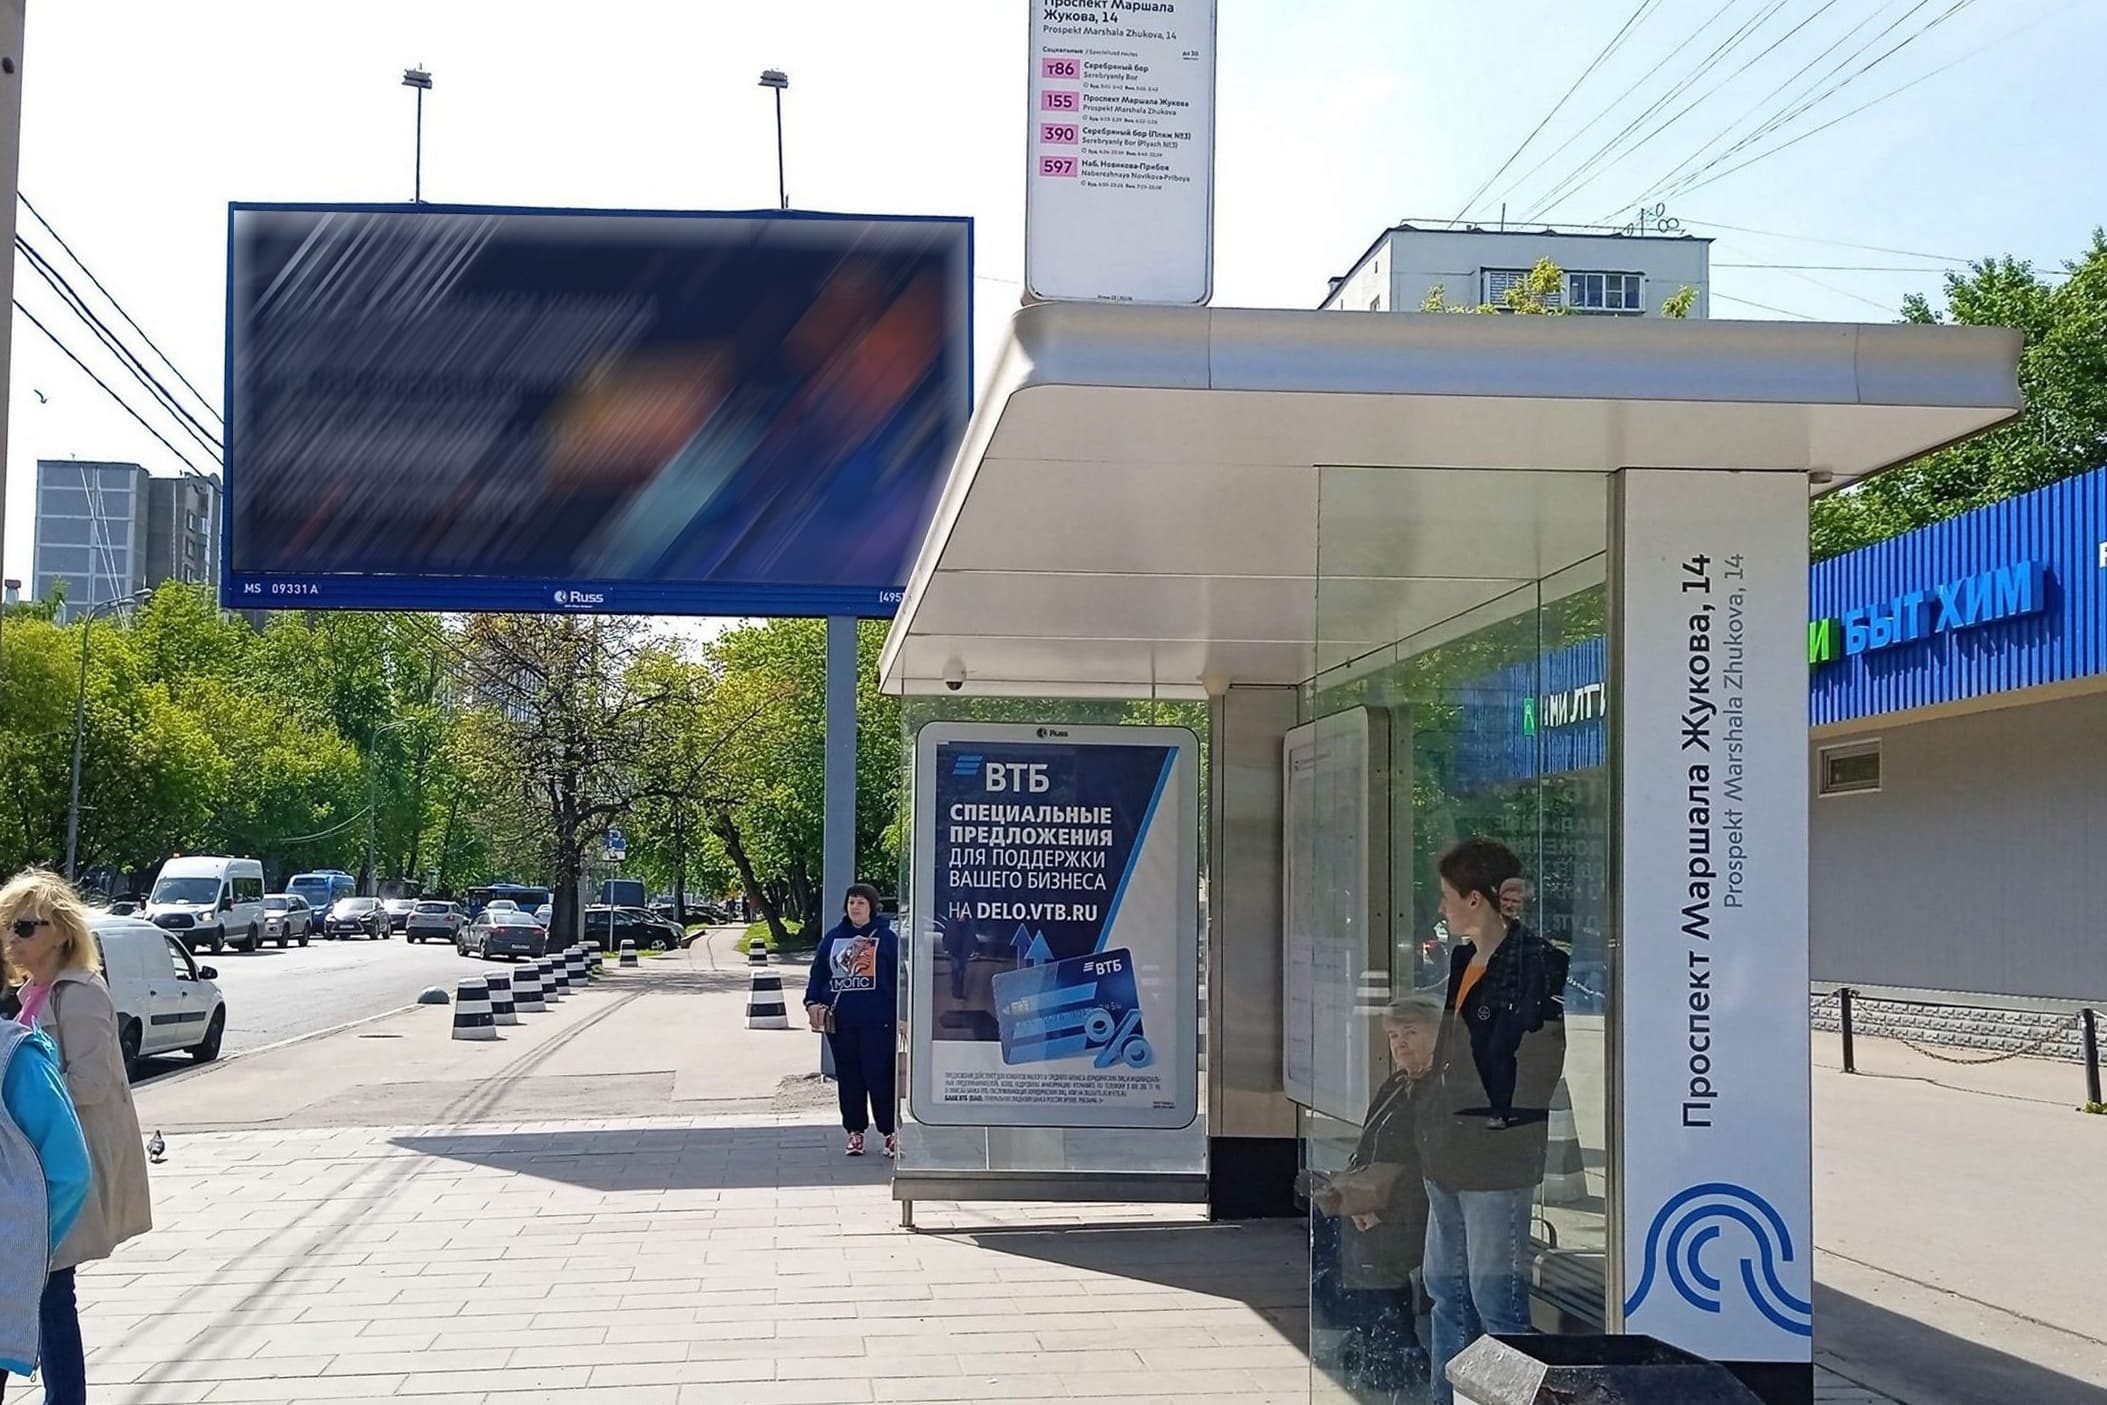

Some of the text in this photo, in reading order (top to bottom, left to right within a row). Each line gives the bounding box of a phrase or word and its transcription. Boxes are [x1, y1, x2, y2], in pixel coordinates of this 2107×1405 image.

[1111, 0, 1174, 12] Маршала
[1044, 9, 1118, 24] Жукова, 14
[1043, 25, 1177, 40] Prospekt Marshala Zhukova, 14
[1084, 61, 1149, 73] Серебряный бор
[1048, 95, 1073, 108] 155
[1083, 94, 1190, 107] Проспект Маршала Жукова
[1045, 127, 1074, 141] 390
[1082, 127, 1131, 136] Серебряный
[1132, 129, 1147, 138] бор
[1044, 160, 1072, 173] 597
[244, 583, 261, 593] MS
[570, 591, 604, 603] Russ
[1845, 590, 1926, 656] БЫТ
[1933, 558, 2035, 634] ХИМ
[1723, 554, 1747, 908] Prospekt Marshala Zhukova, 14
[985, 762, 1049, 793] ВТБ
[950, 804, 1112, 825] СПЕЦИАЛЬНЫЕ
[950, 826, 1113, 847] ПРЕДЛОЖЕНИЯ
[1681, 554, 1717, 1128] Проспект Маршала Жукова, 14
[949, 848, 1105, 870] ДЛЯ ПОДДЕРЖКИ
[950, 871, 1106, 891] ВАШЕГО БИЗНЕСА
[949, 902, 1098, 921] НА DELO.VTB.RU
[1096, 959, 1122, 975] ВТБ
